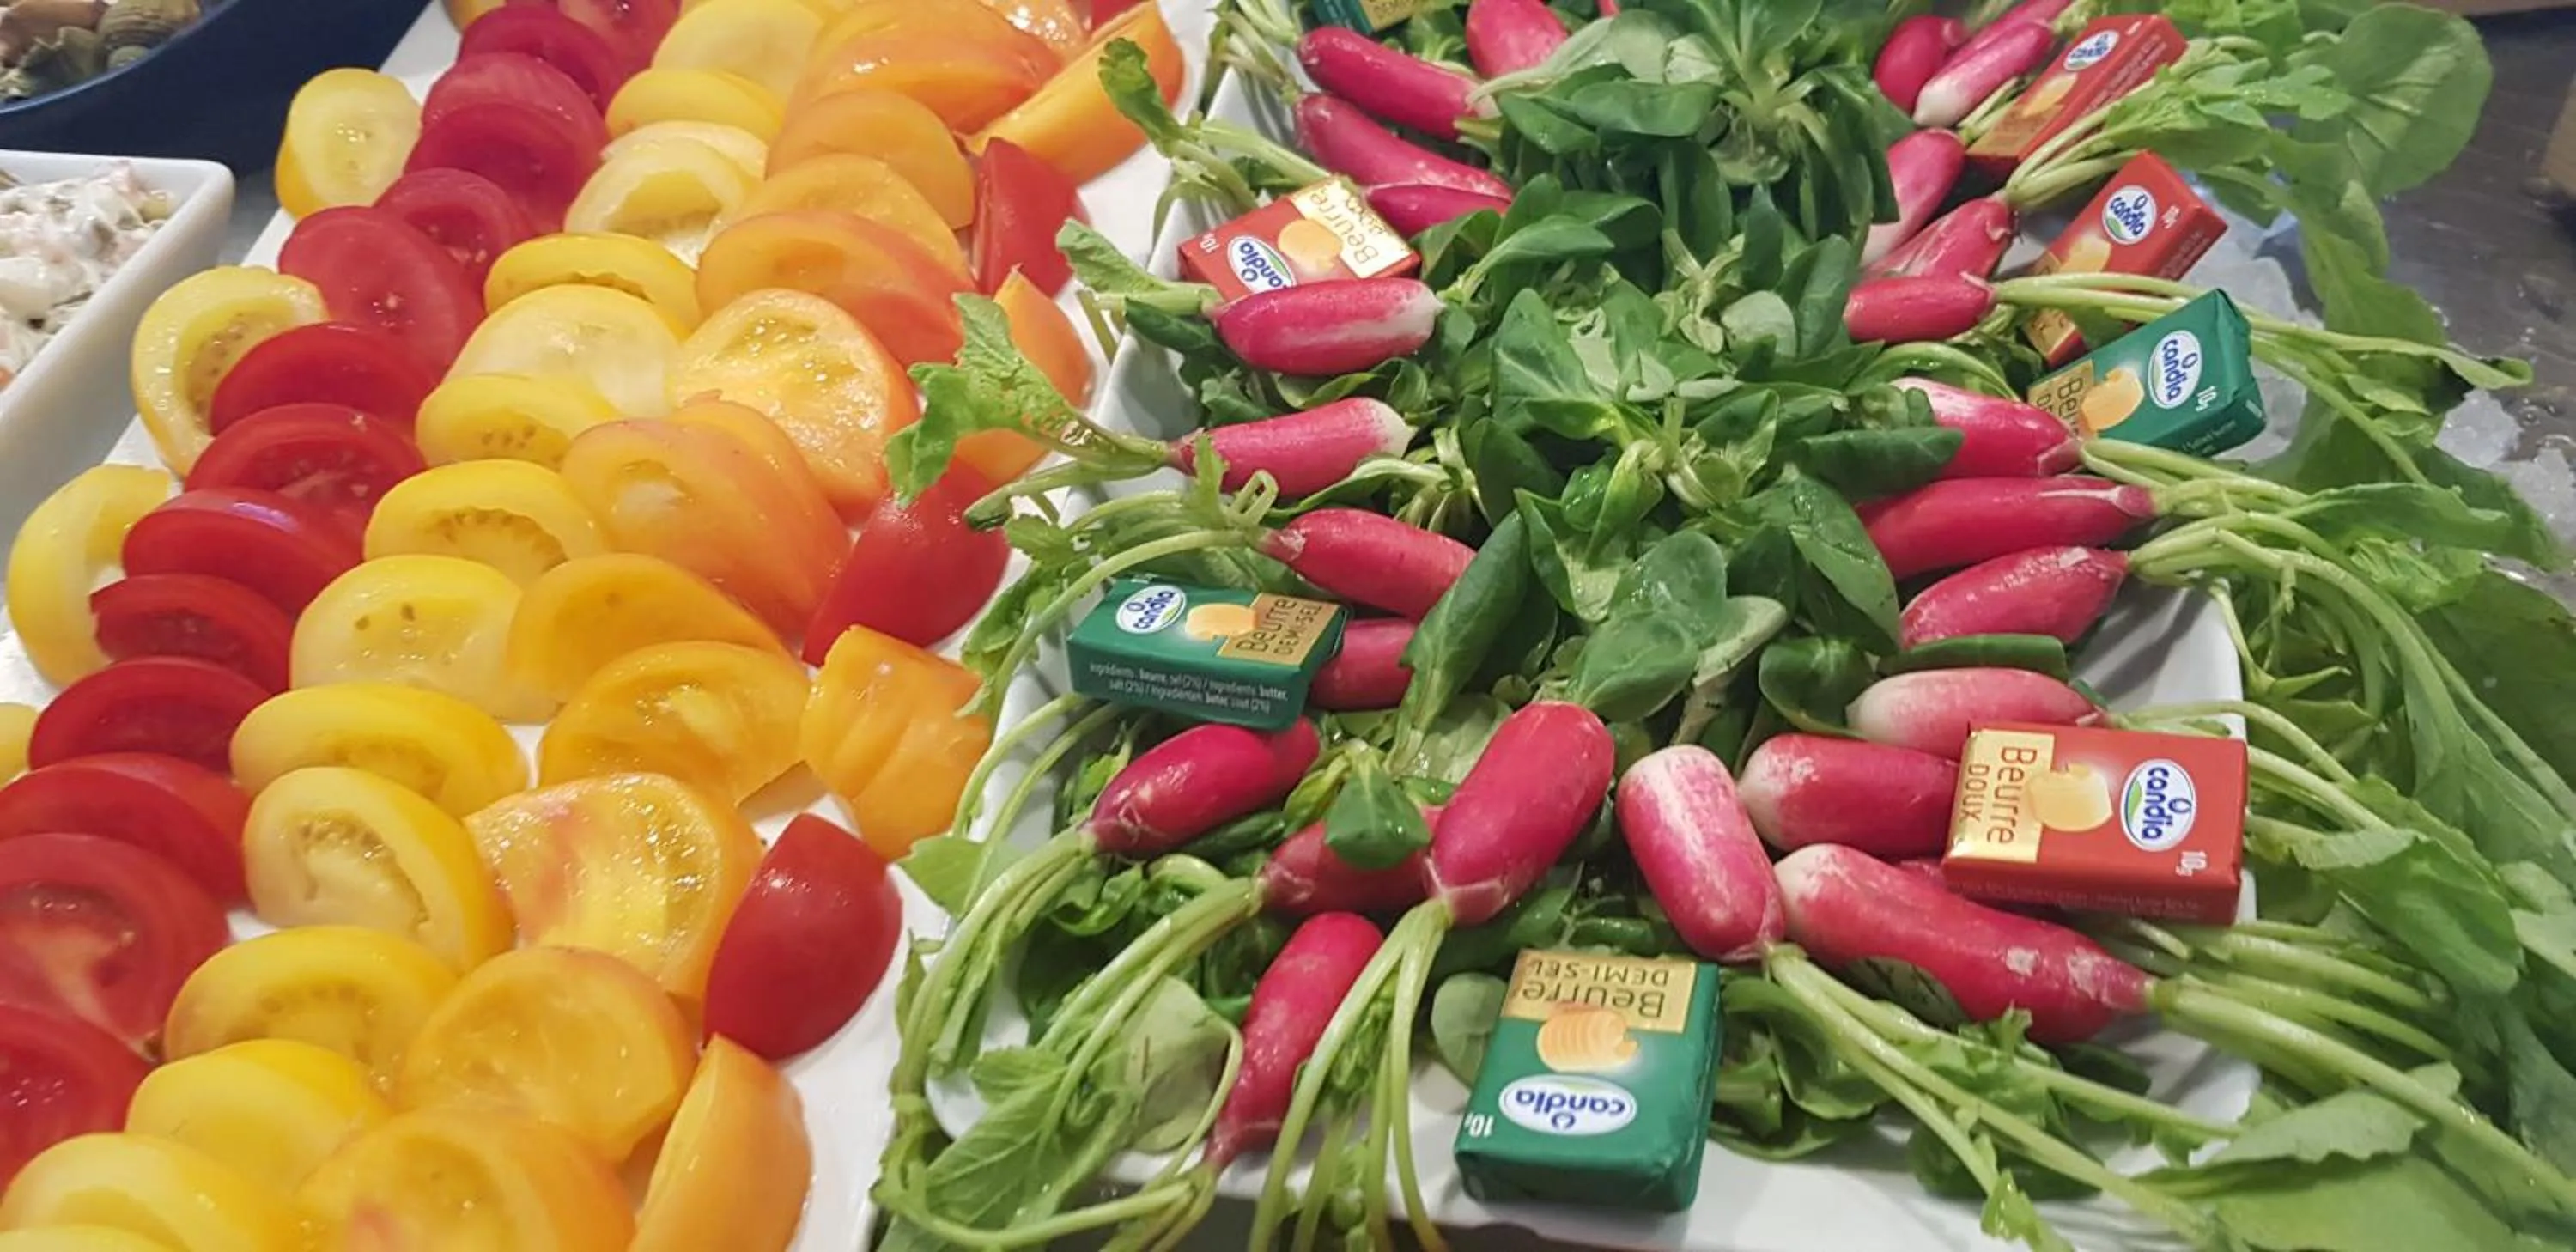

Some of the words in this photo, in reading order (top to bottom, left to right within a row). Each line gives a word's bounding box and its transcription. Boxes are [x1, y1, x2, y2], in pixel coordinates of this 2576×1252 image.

[1240, 241, 1288, 289] andia
[1236, 598, 1298, 653] Beurre
[1960, 763, 1990, 824] DOUX
[1986, 745, 2038, 845] Beurre
[2142, 766, 2172, 841] candia
[1529, 958, 1670, 987] DEMI-SEL
[1522, 980, 1667, 1019] Beurre
[1515, 1088, 1626, 1115] candia
